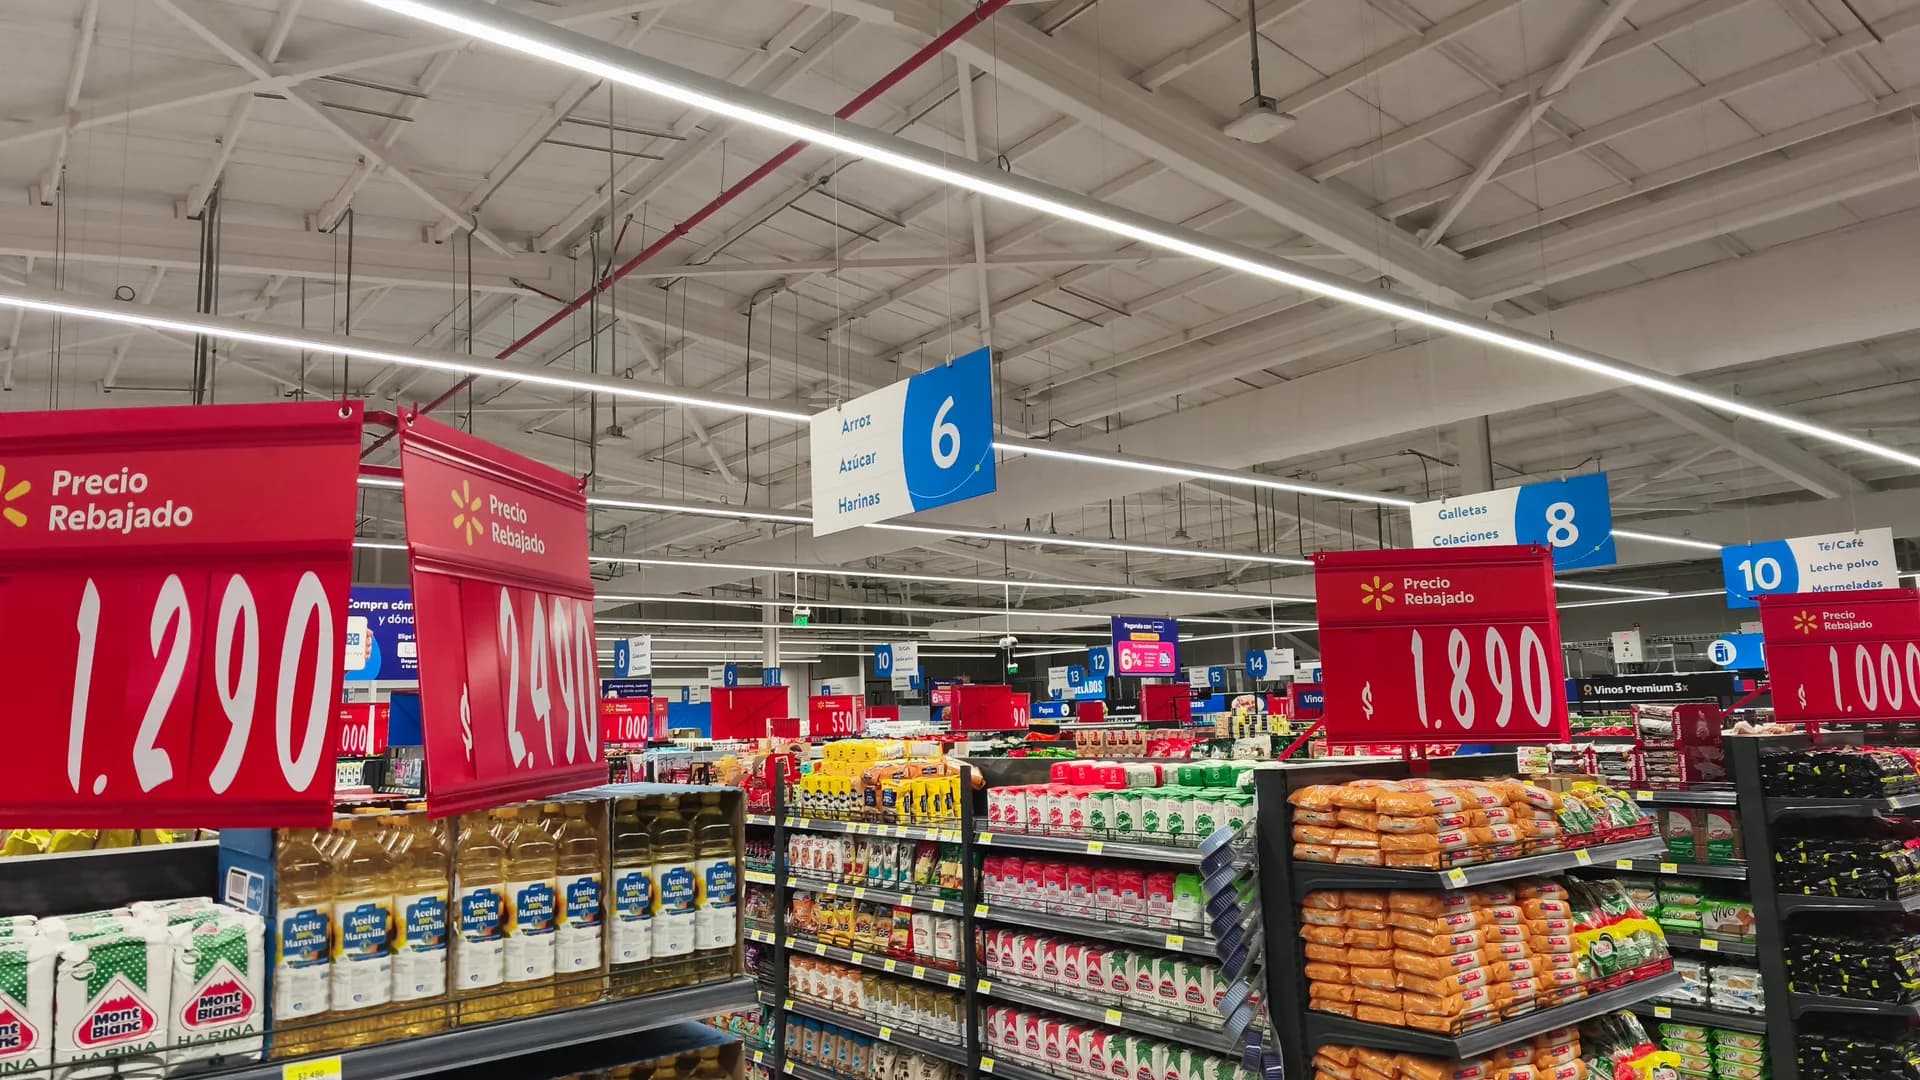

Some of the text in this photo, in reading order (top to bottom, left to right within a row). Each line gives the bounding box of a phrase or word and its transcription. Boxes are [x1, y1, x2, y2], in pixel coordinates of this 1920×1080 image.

[842, 414, 871, 436] Arroz
[931, 396, 960, 469] 6
[839, 452, 876, 474] Azúcar
[52, 468, 148, 498] Precio
[489, 494, 527, 525] Precio
[838, 492, 880, 514] Harinas
[48, 500, 193, 534] Rebajado
[1438, 504, 1488, 520] Galletas
[1545, 502, 1579, 547] 8
[491, 524, 545, 554] Rebajado
[1432, 530, 1499, 546] Colaciones
[1818, 538, 1864, 552] Té/Café
[1810, 558, 1879, 572] Leche polvo
[1738, 557, 1782, 591] 10
[1404, 577, 1450, 589] Precio
[1812, 580, 1883, 592] Mermeladas
[1405, 591, 1474, 606] Rebajado
[378, 616, 385, 626] y
[1823, 611, 1856, 620] Precio
[1824, 620, 1872, 630] Rebajado
[618, 648, 624, 668] 8
[878, 652, 889, 669] 10
[1093, 654, 1104, 670] 12
[1121, 648, 1142, 670] 6%
[1250, 657, 1263, 670] 14
[67, 570, 334, 797] 1.290
[460, 586, 598, 768] $ 2.490
[728, 671, 733, 685] 9
[1071, 670, 1079, 682] 13
[1211, 672, 1220, 682] 15
[1361, 625, 1551, 730] $ 1.890
[1594, 682, 1688, 695] Vinos Premium 3x
[1798, 684, 1806, 710] $
[618, 715, 648, 740] 1.000
[832, 711, 852, 733] 550
[667, 876, 688, 886] Aceite
[712, 871, 731, 880] Aceite
[574, 888, 596, 897] Aceite
[623, 882, 645, 891] Aceite
[663, 889, 693, 898] Maravilla
[469, 899, 495, 909] Aceite
[524, 894, 549, 904] Aceite
[414, 907, 440, 918] Aceite
[291, 921, 320, 932] Aceite
[351, 915, 380, 927] Aceite
[408, 920, 444, 932] Maravilla
[284, 936, 325, 948] Maravilla
[344, 929, 384, 941] Maravilla
[200, 992, 242, 1008] Mont
[94, 1007, 140, 1026] Mont
[198, 1002, 243, 1020] Blanc
[0, 1023, 18, 1034] nt
[92, 1020, 140, 1039] Blanc
[178, 1023, 255, 1046] HARINA
